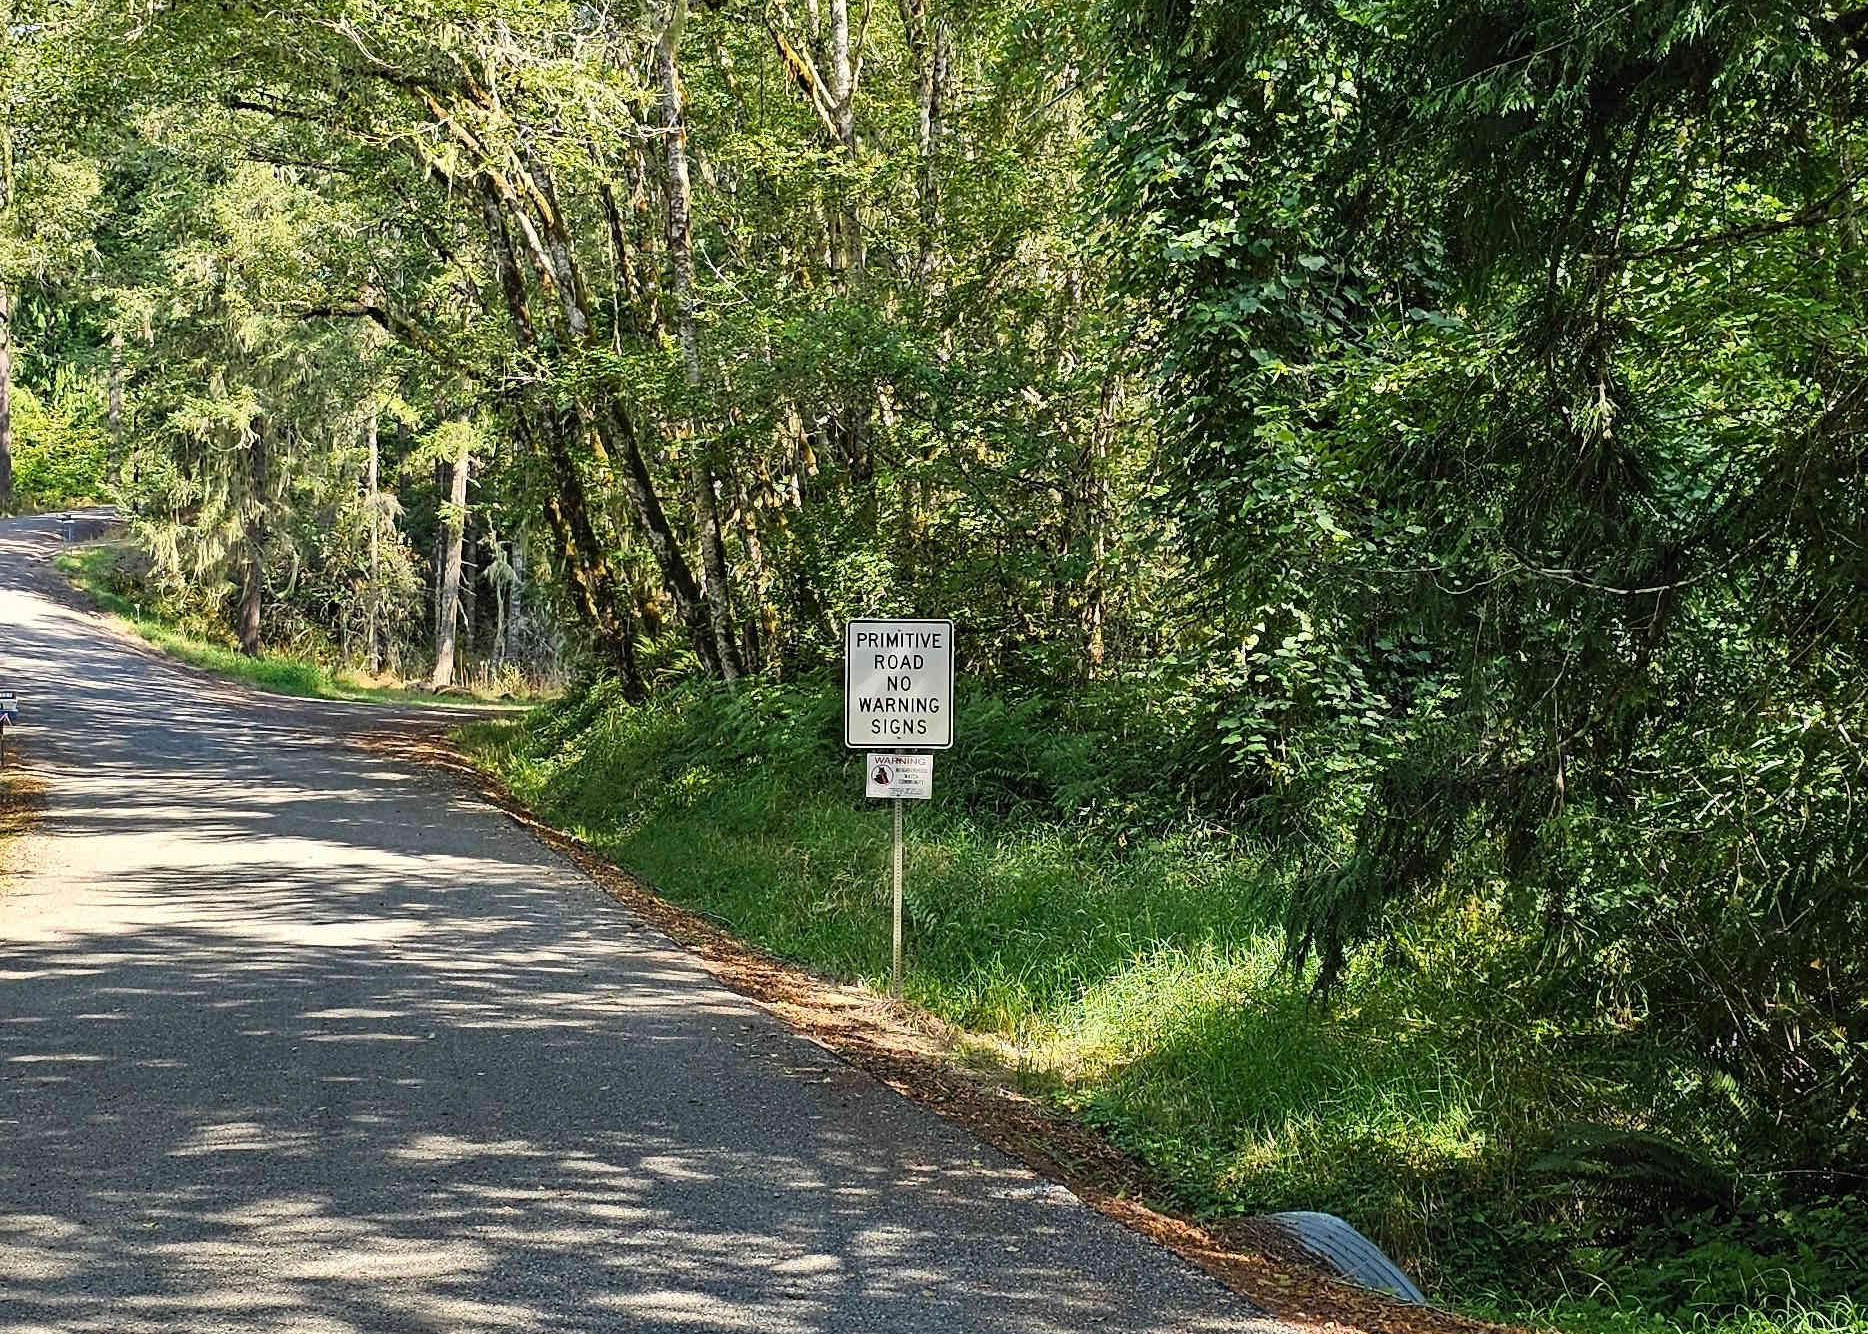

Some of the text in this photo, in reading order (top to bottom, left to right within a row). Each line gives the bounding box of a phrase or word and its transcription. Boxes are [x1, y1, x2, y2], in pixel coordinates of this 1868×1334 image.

[857, 633, 942, 649] PRIMITIVE
[874, 655, 924, 670] ROAD
[887, 676, 912, 691] NO
[859, 698, 940, 713] WARNING
[871, 719, 927, 734] SIGNS
[874, 757, 926, 765] WARNING
